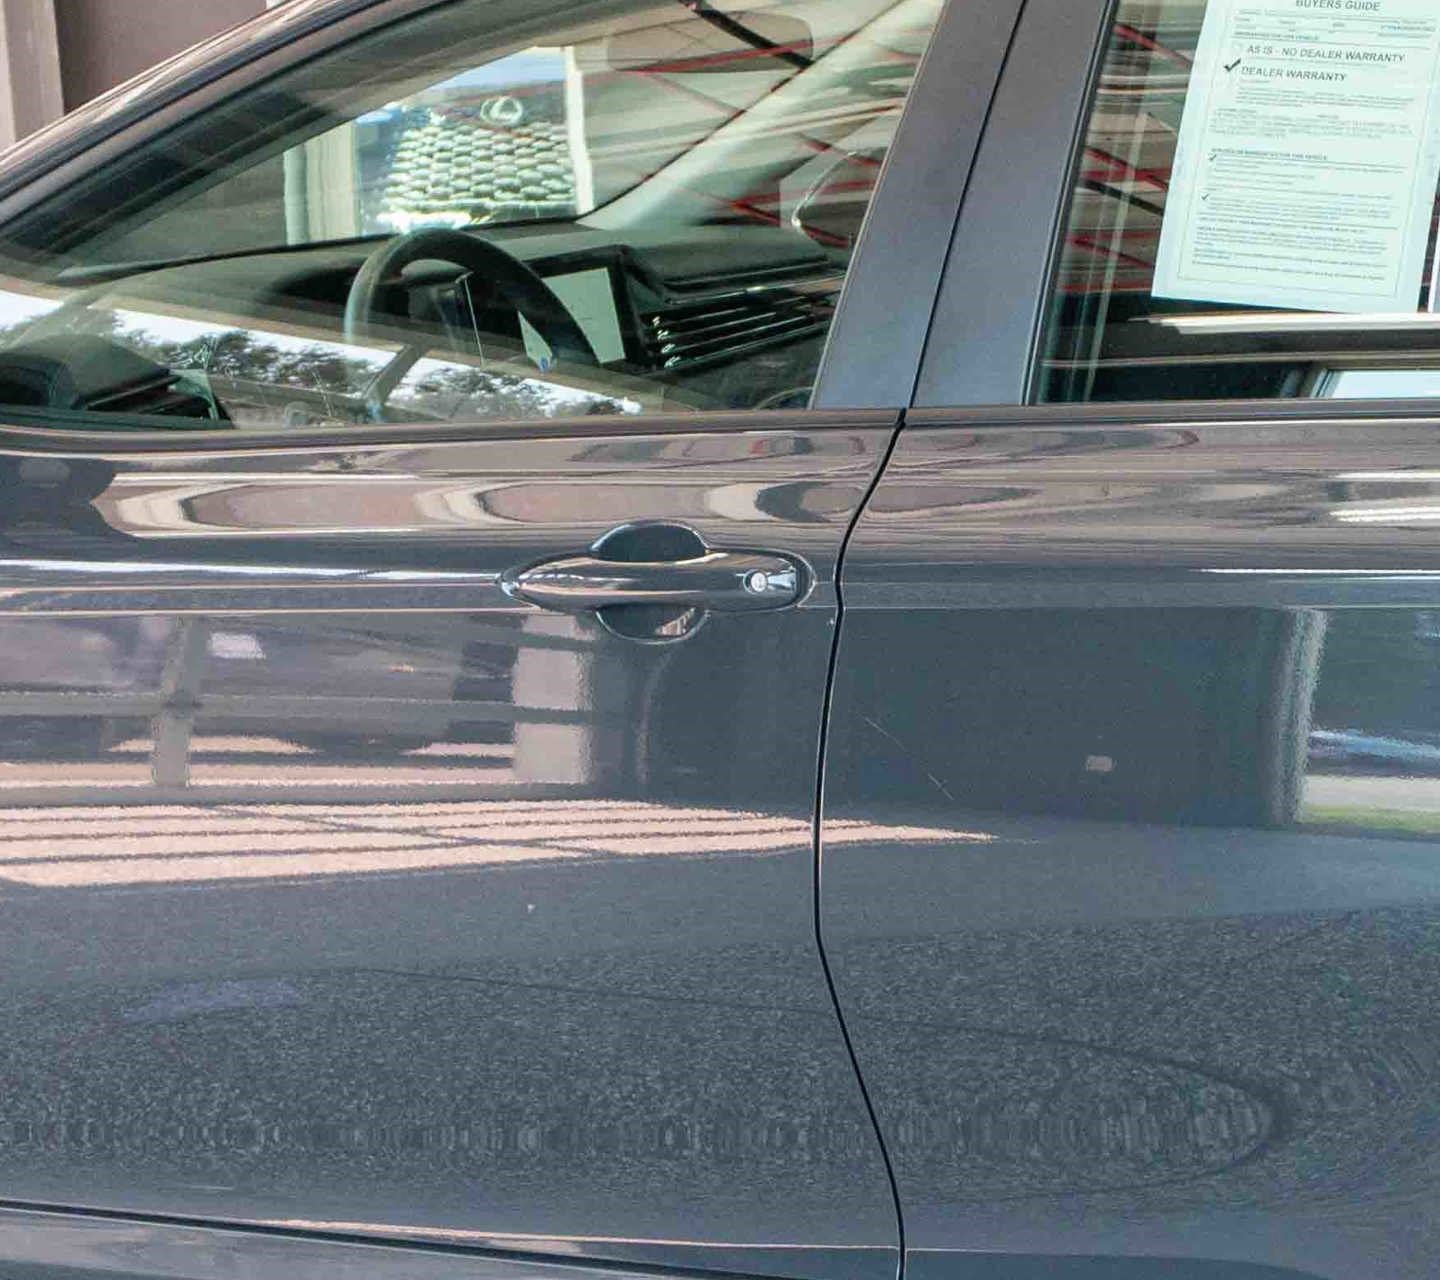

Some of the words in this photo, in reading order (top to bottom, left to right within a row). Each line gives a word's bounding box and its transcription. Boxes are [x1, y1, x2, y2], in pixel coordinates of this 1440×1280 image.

[1345, 0, 1381, 12] GUIDE
[1247, 44, 1261, 54] AS
[1262, 45, 1273, 55] IS
[1281, 47, 1298, 58] NO
[1300, 48, 1343, 60] DEALER
[1345, 50, 1406, 63] WARRANTY
[1240, 66, 1284, 79] DEALER
[1286, 68, 1348, 82] WARRANTY
